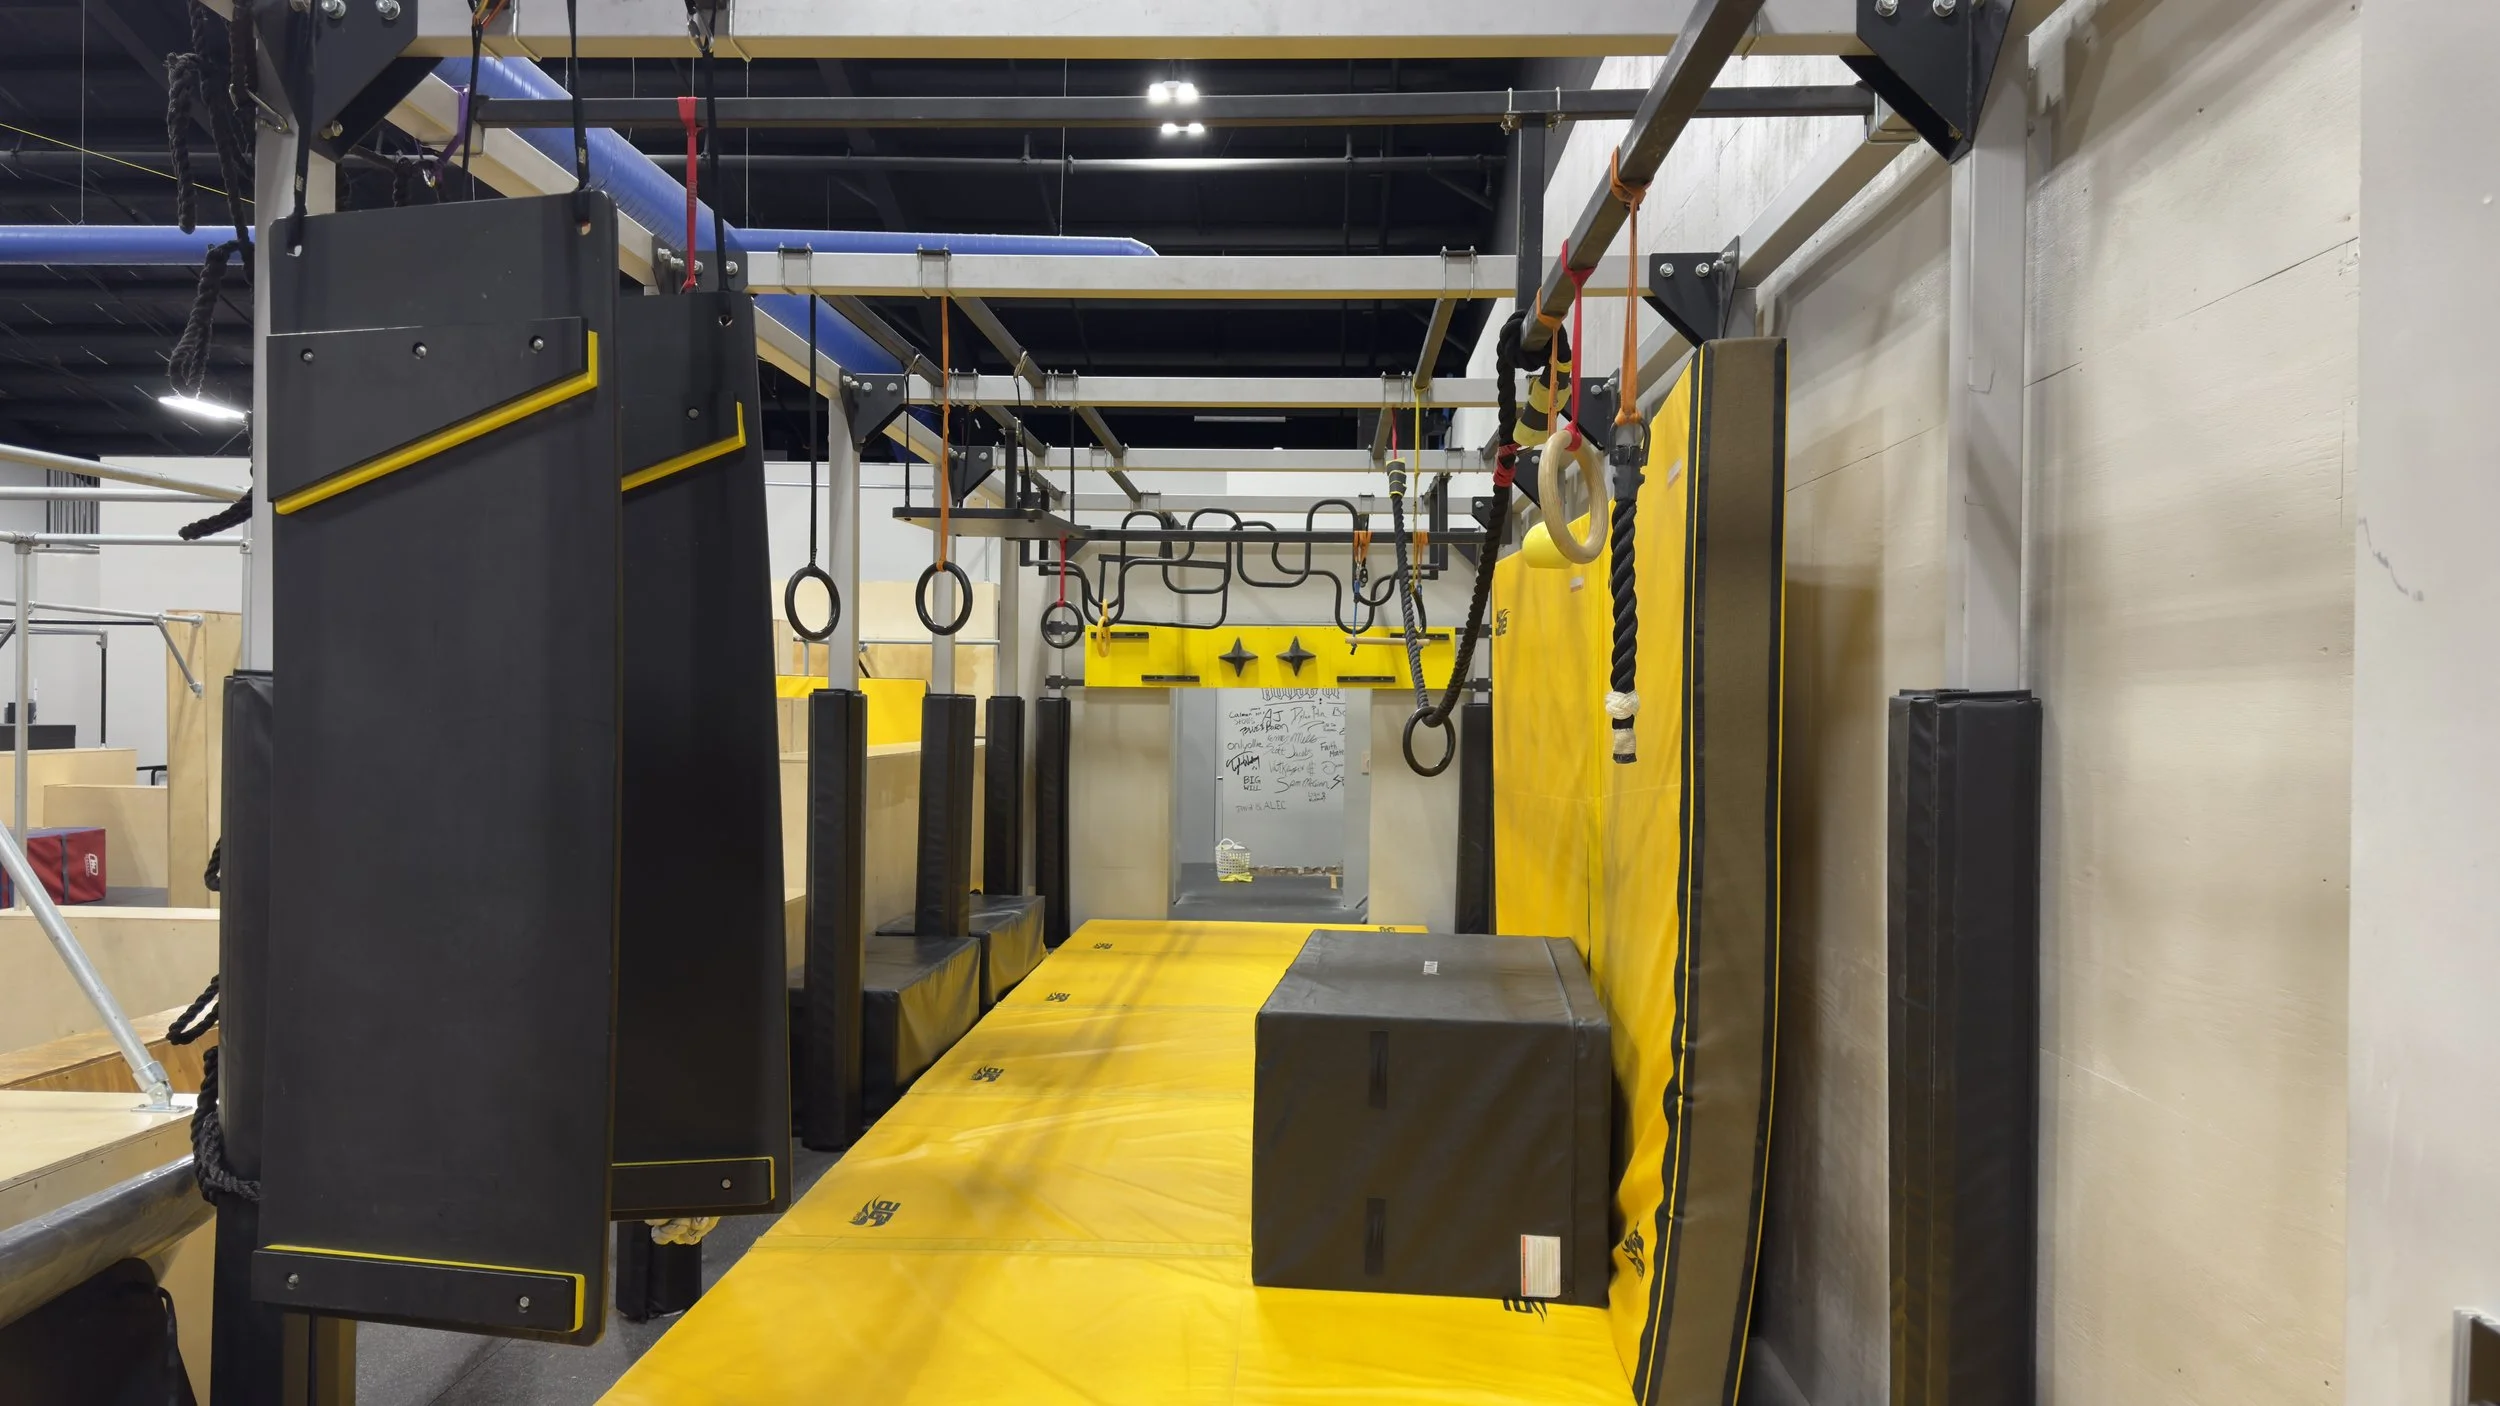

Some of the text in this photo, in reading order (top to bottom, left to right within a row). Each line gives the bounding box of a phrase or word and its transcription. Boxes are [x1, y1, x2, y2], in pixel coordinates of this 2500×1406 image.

[1261, 708, 1284, 724] AJ
[1243, 775, 1261, 785] BIG
[1243, 784, 1262, 792] WILL
